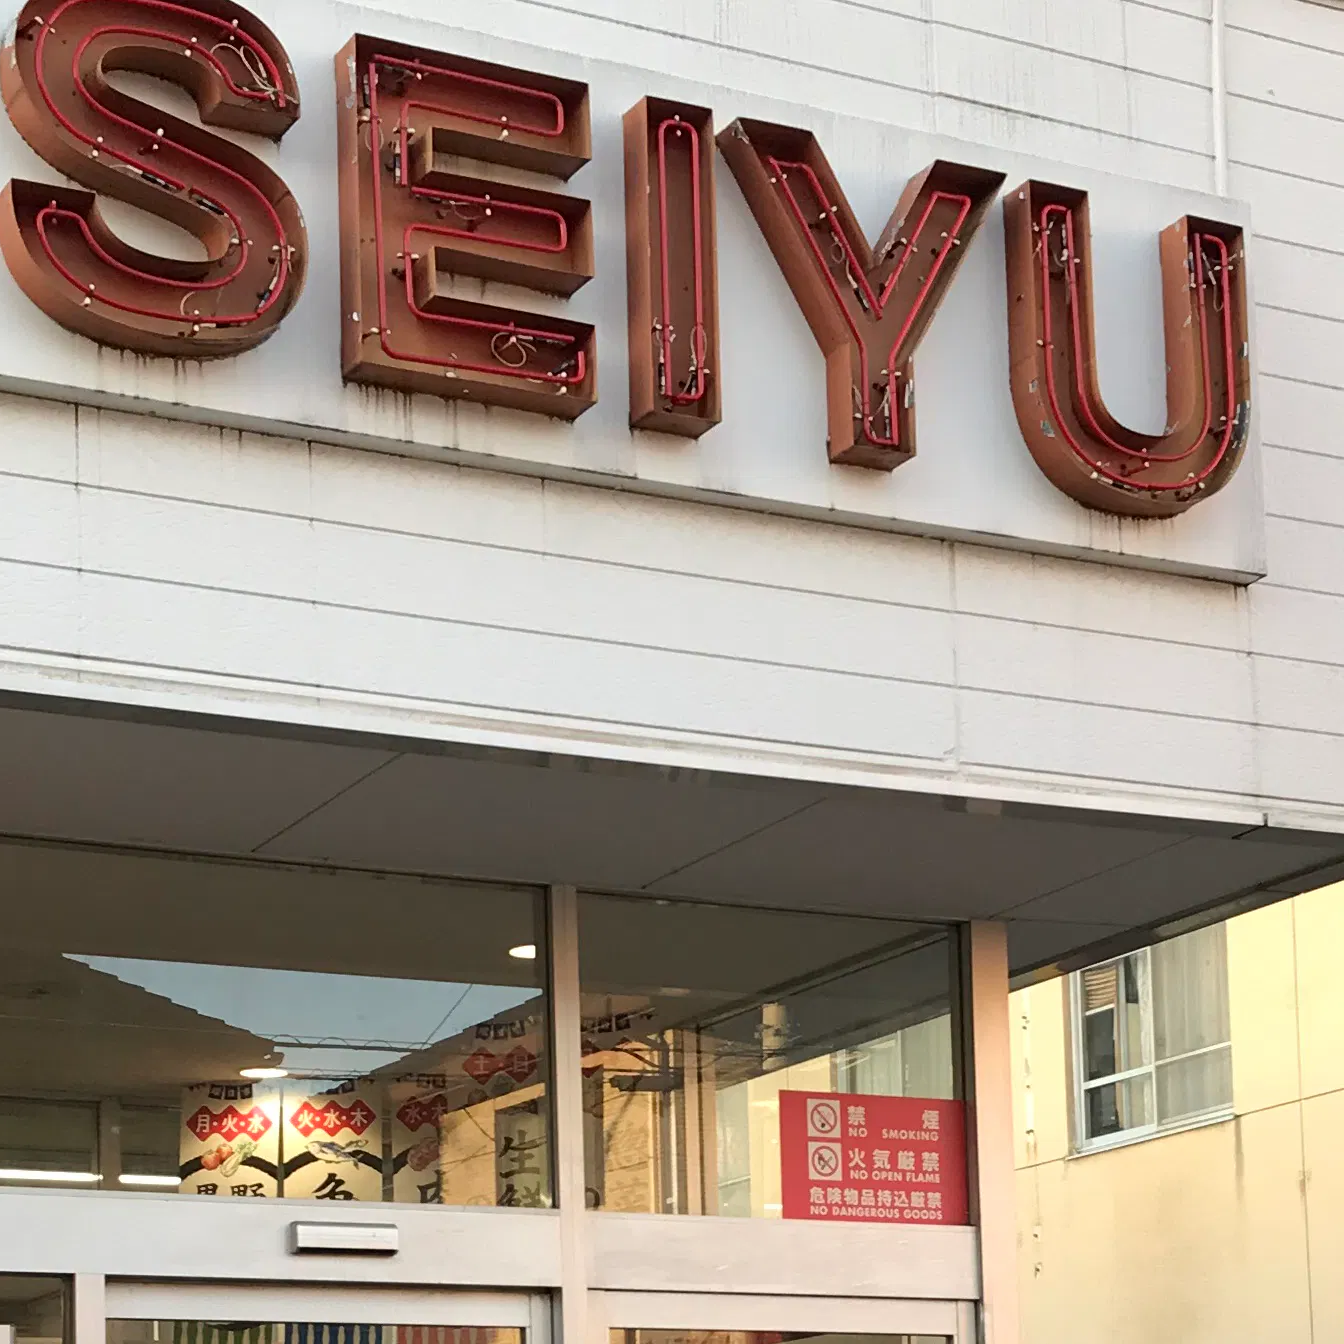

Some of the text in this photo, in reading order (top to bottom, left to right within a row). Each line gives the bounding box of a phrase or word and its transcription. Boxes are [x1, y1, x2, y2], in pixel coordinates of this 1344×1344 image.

[848, 1127, 939, 1142] NO SMOKING
[848, 1148, 940, 1172] 火気厳禁
[850, 1170, 941, 1184] NO OPEN FLAME
[809, 1186, 942, 1209] 危険物品持込厳禁
[810, 1205, 943, 1220] NO DANGEROUS GOODS
